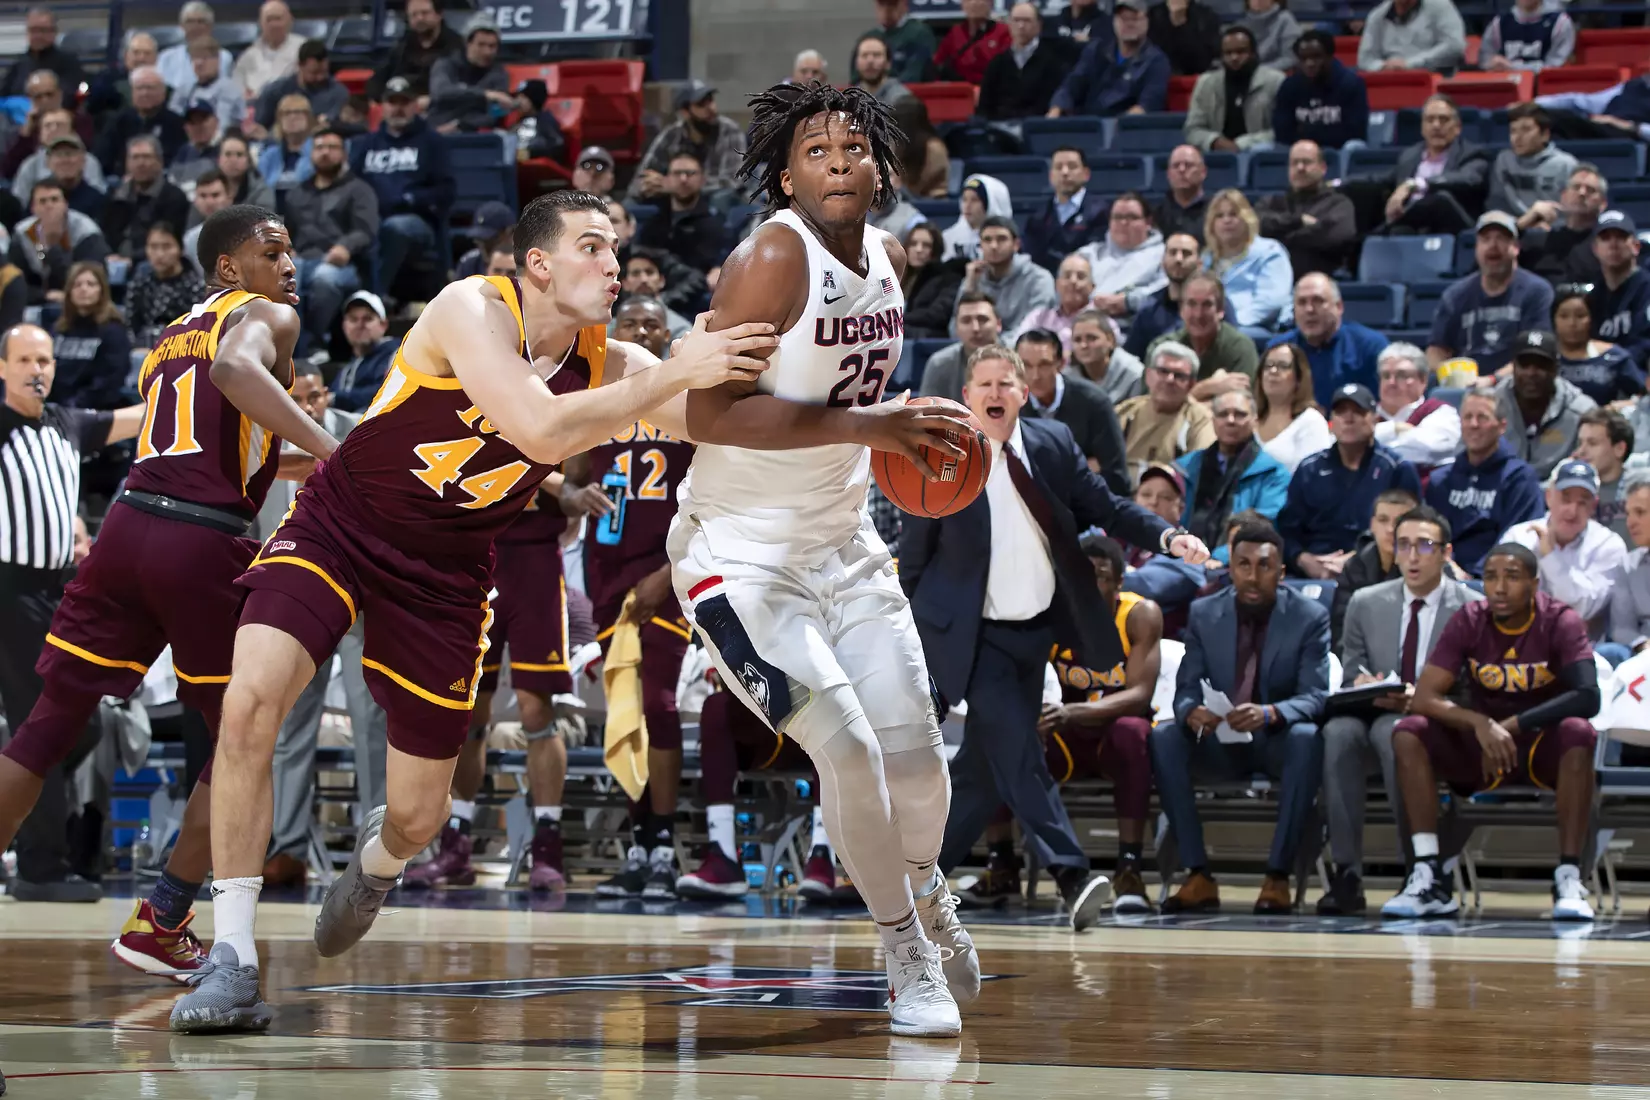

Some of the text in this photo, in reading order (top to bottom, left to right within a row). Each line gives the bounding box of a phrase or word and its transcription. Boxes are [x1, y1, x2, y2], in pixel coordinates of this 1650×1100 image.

[560, 0, 633, 35] 121
[814, 306, 904, 347] UCONN
[826, 348, 890, 408] 25
[134, 363, 204, 464] 11
[409, 435, 532, 510] 44
[613, 448, 668, 500] 12
